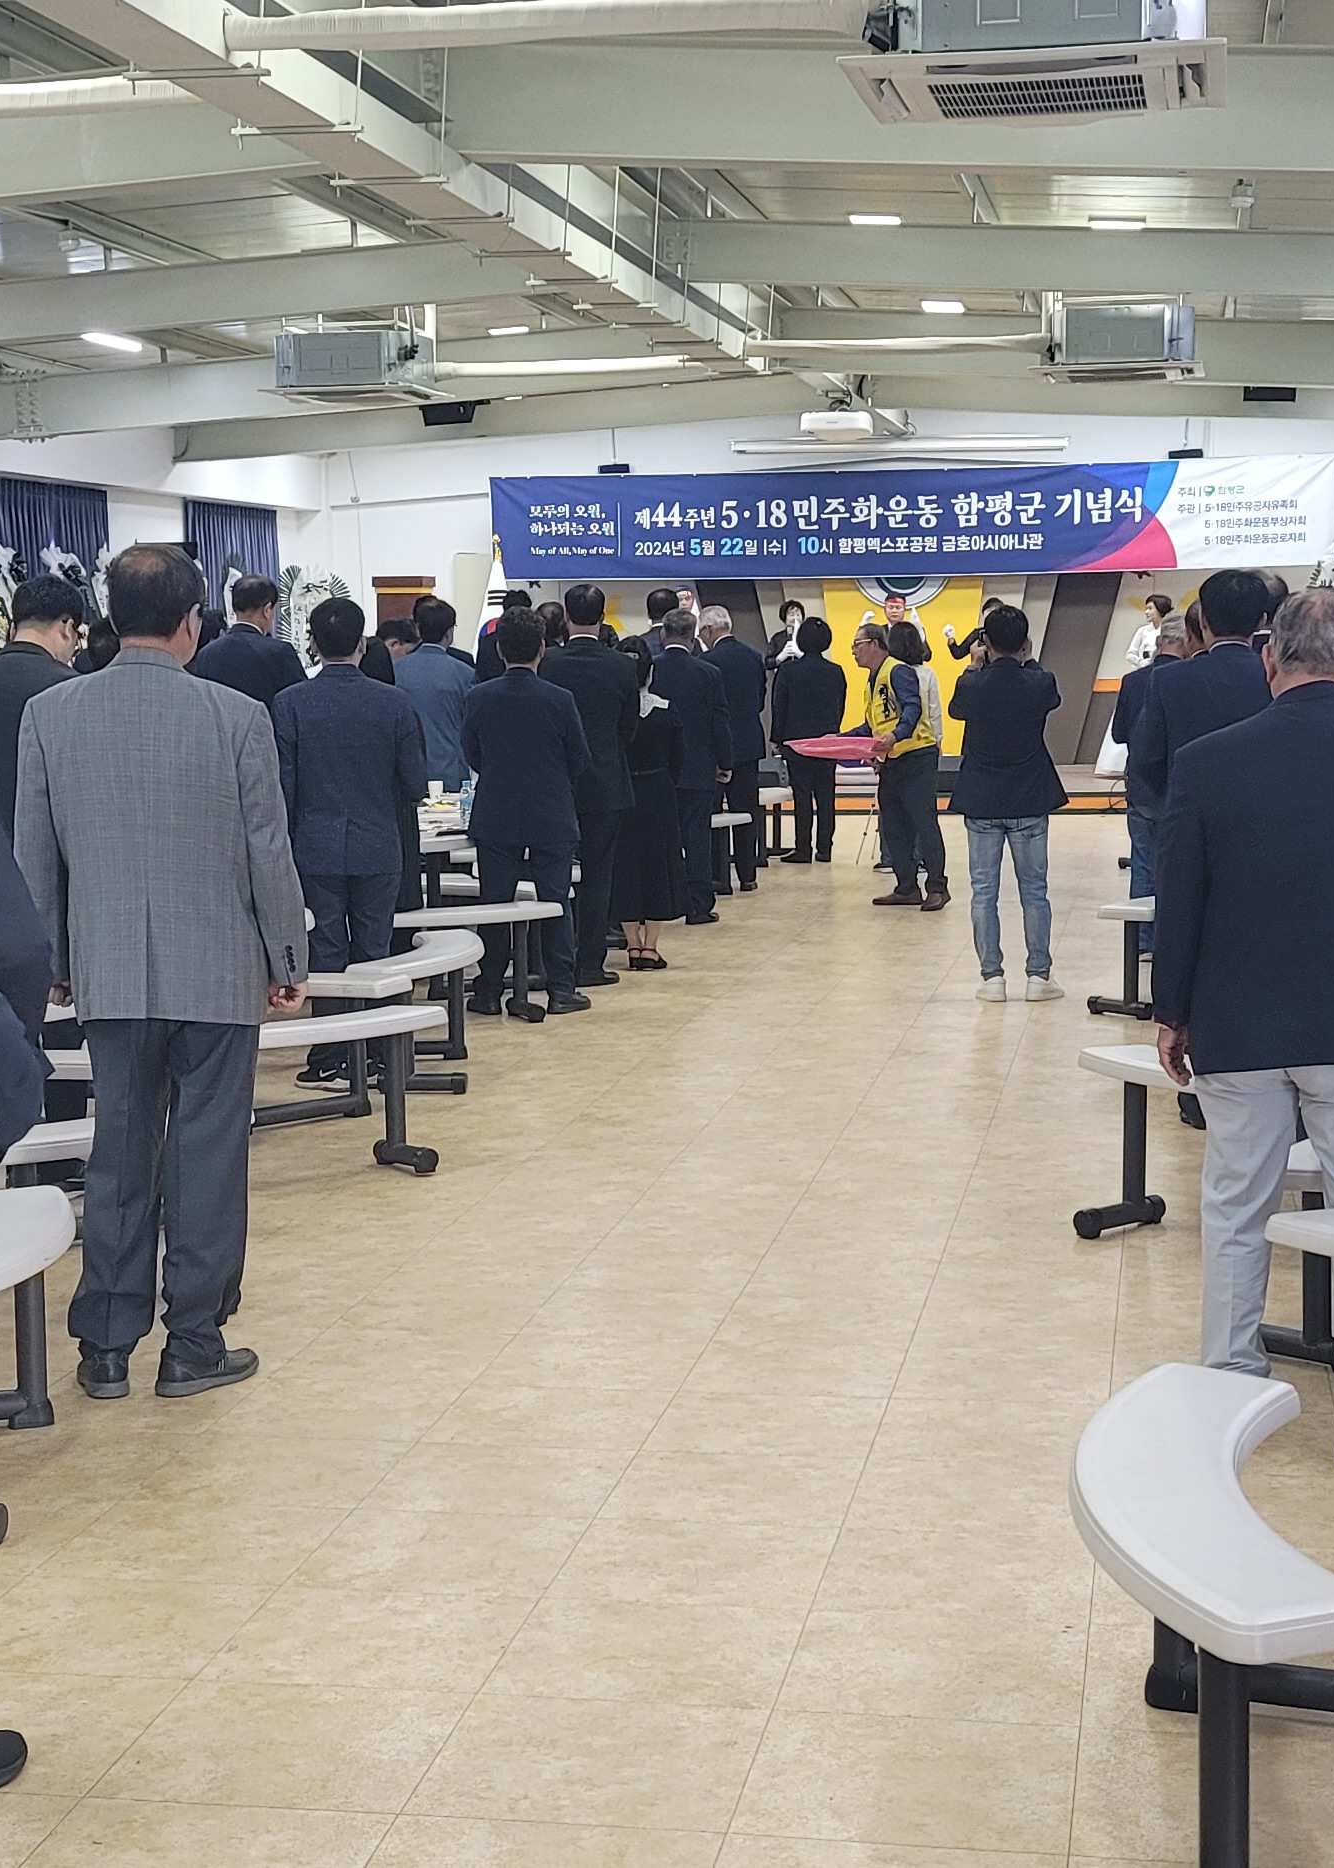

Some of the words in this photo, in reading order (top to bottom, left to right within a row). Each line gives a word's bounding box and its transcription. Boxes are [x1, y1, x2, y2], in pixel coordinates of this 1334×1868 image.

[529, 503, 569, 518] 모두의
[573, 503, 606, 519] 오월,
[634, 501, 716, 530] 제44주년
[950, 491, 1046, 528] 함평군
[1054, 486, 1144, 525] 기념식
[529, 521, 585, 537] 하나되는
[587, 520, 616, 536] 오월
[530, 546, 546, 557] May
[634, 541, 685, 556] 2024년
[689, 538, 716, 556] 5월
[720, 537, 758, 556] 22일
[797, 536, 833, 555] 10시
[838, 535, 938, 555] 함평엑스포공원
[941, 532, 1044, 552] 금호아시아나관
